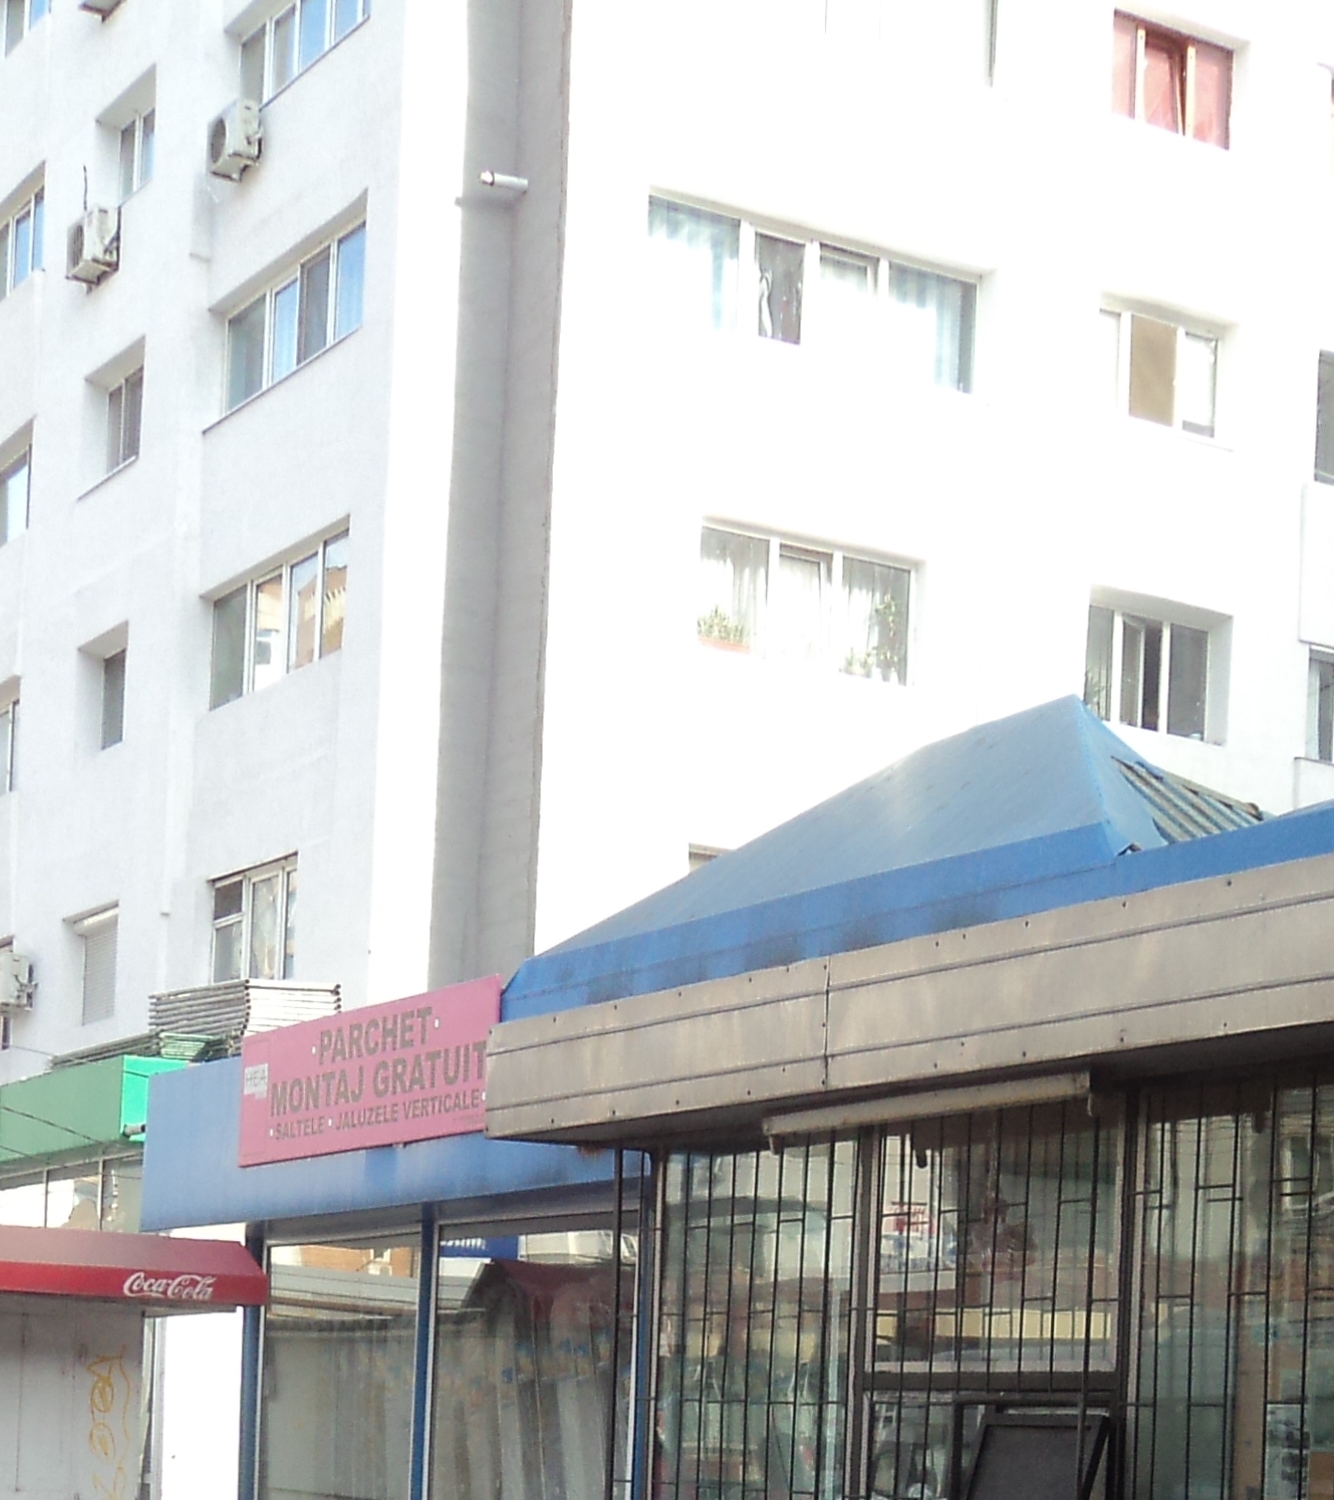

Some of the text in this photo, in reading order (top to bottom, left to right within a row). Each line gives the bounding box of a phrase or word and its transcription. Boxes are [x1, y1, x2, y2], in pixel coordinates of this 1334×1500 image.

[318, 1006, 433, 1066] PARCHET
[270, 1040, 488, 1118] MONTAJ GRATUIT
[274, 1116, 325, 1141] SALTELE
[335, 1103, 399, 1131] JALUZELE
[402, 1088, 481, 1121] VERTICALE
[123, 1271, 217, 1301] Coca-Cola
